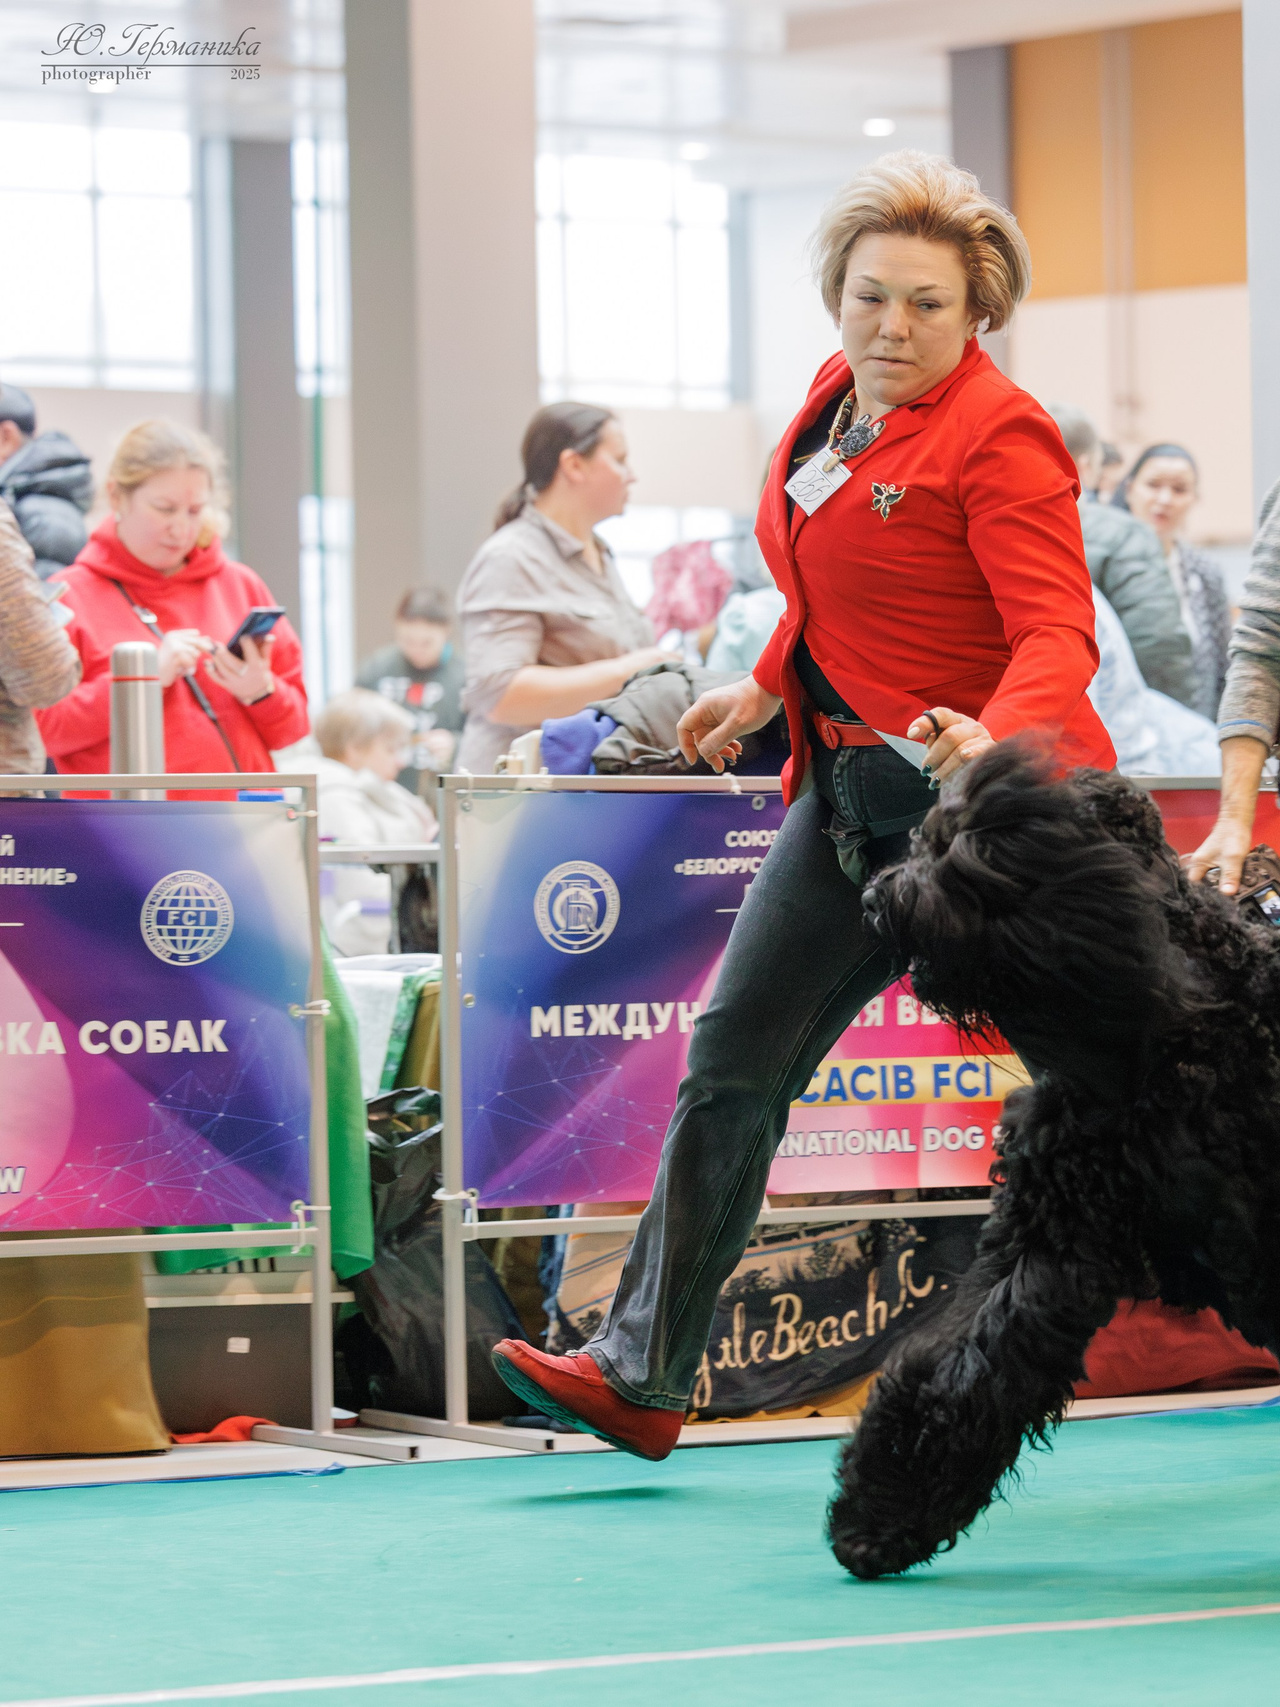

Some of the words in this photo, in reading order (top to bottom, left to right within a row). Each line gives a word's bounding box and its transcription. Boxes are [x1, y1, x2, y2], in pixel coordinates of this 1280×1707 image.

[790, 469, 830, 502] 266
[0, 867, 78, 886] НЕНИЕ»
[167, 911, 207, 926] FCI
[78, 1019, 229, 1055] СОБАК
[933, 1062, 993, 1099] FCI
[774, 1125, 917, 1158] NATIONAL
[923, 1124, 985, 1153] DOG
